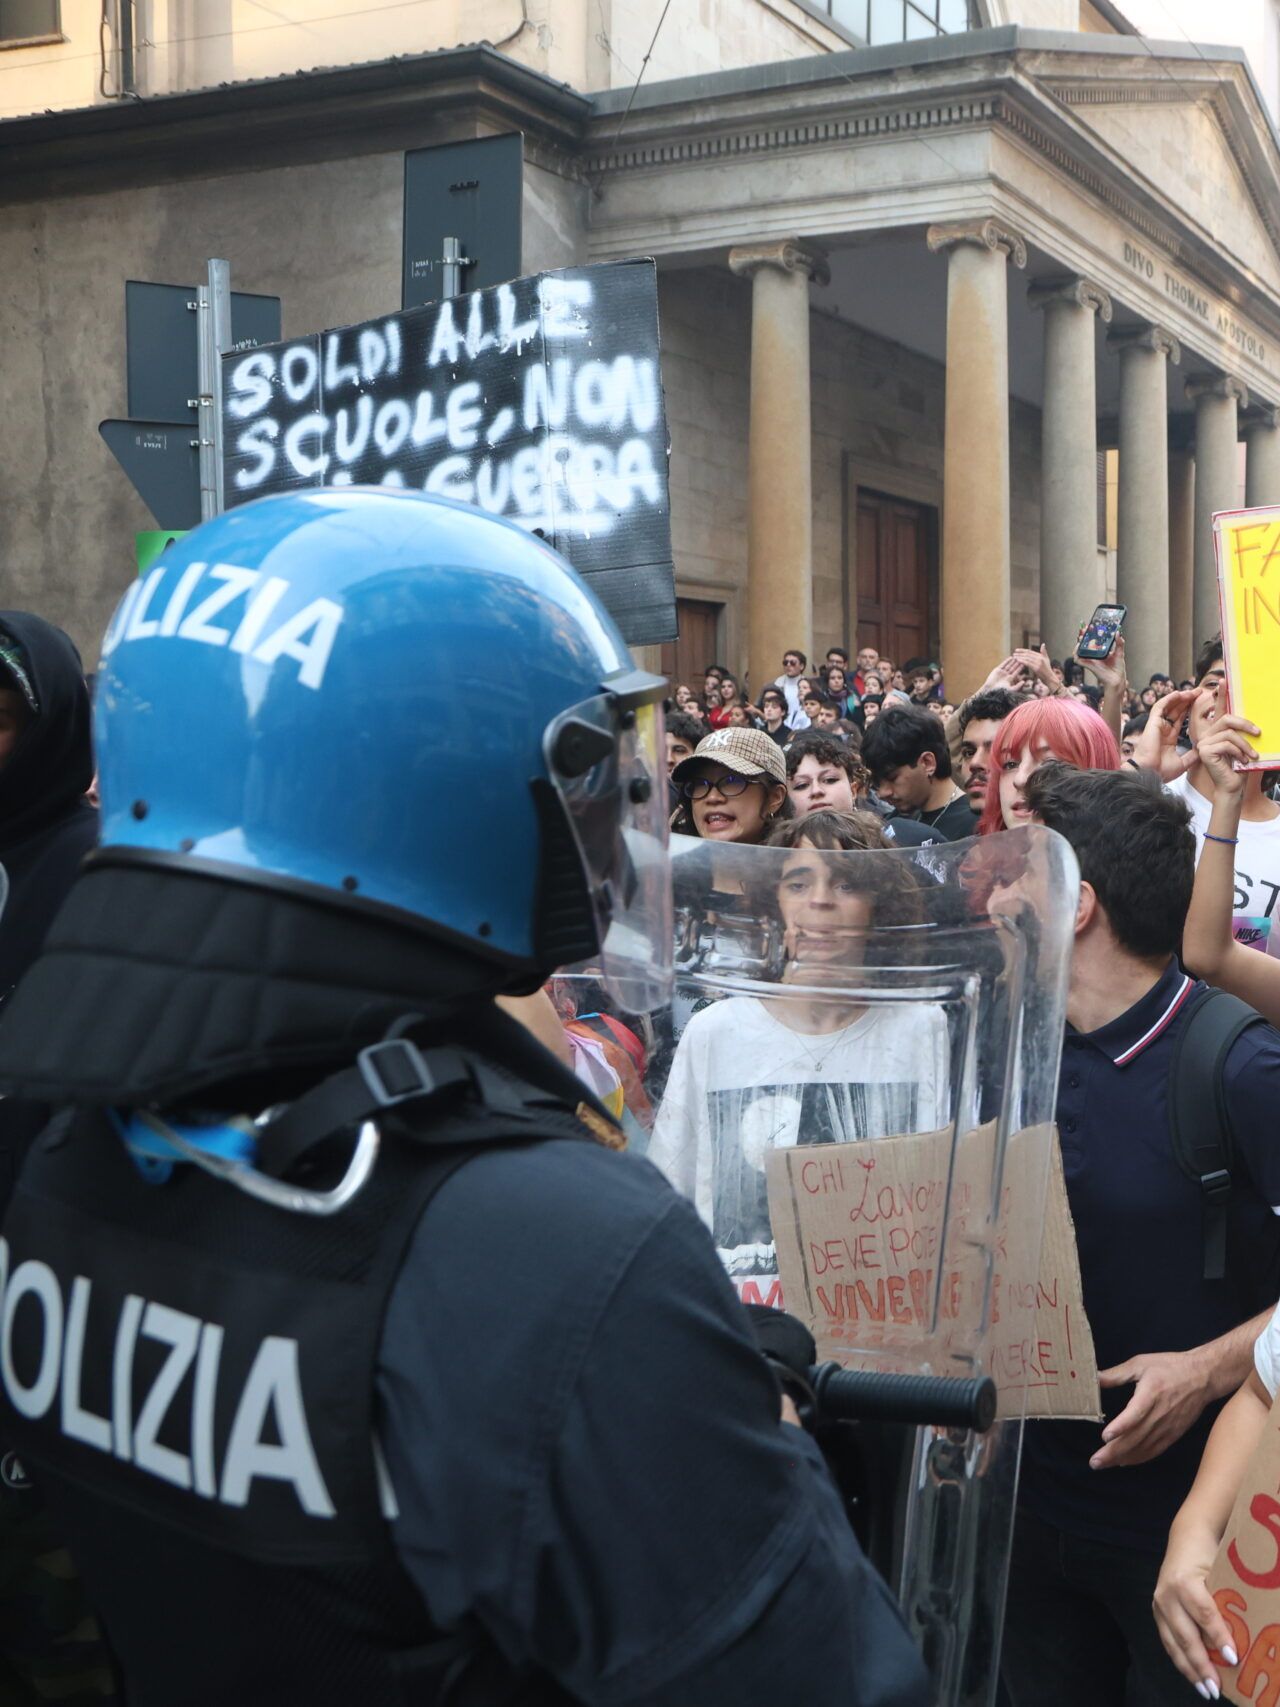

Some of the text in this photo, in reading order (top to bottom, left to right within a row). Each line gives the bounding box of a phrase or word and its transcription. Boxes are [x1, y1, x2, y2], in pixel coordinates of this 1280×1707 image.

[1123, 241, 1265, 361] DIVO THOMAE APOSTOLO
[228, 276, 594, 418] SOLDI ALLE
[522, 354, 661, 434] NON
[1235, 927, 1261, 941] NIKE
[801, 1158, 845, 1194] CHI
[810, 1234, 881, 1275] DEVE
[0, 1236, 337, 1518] OLIZIA
